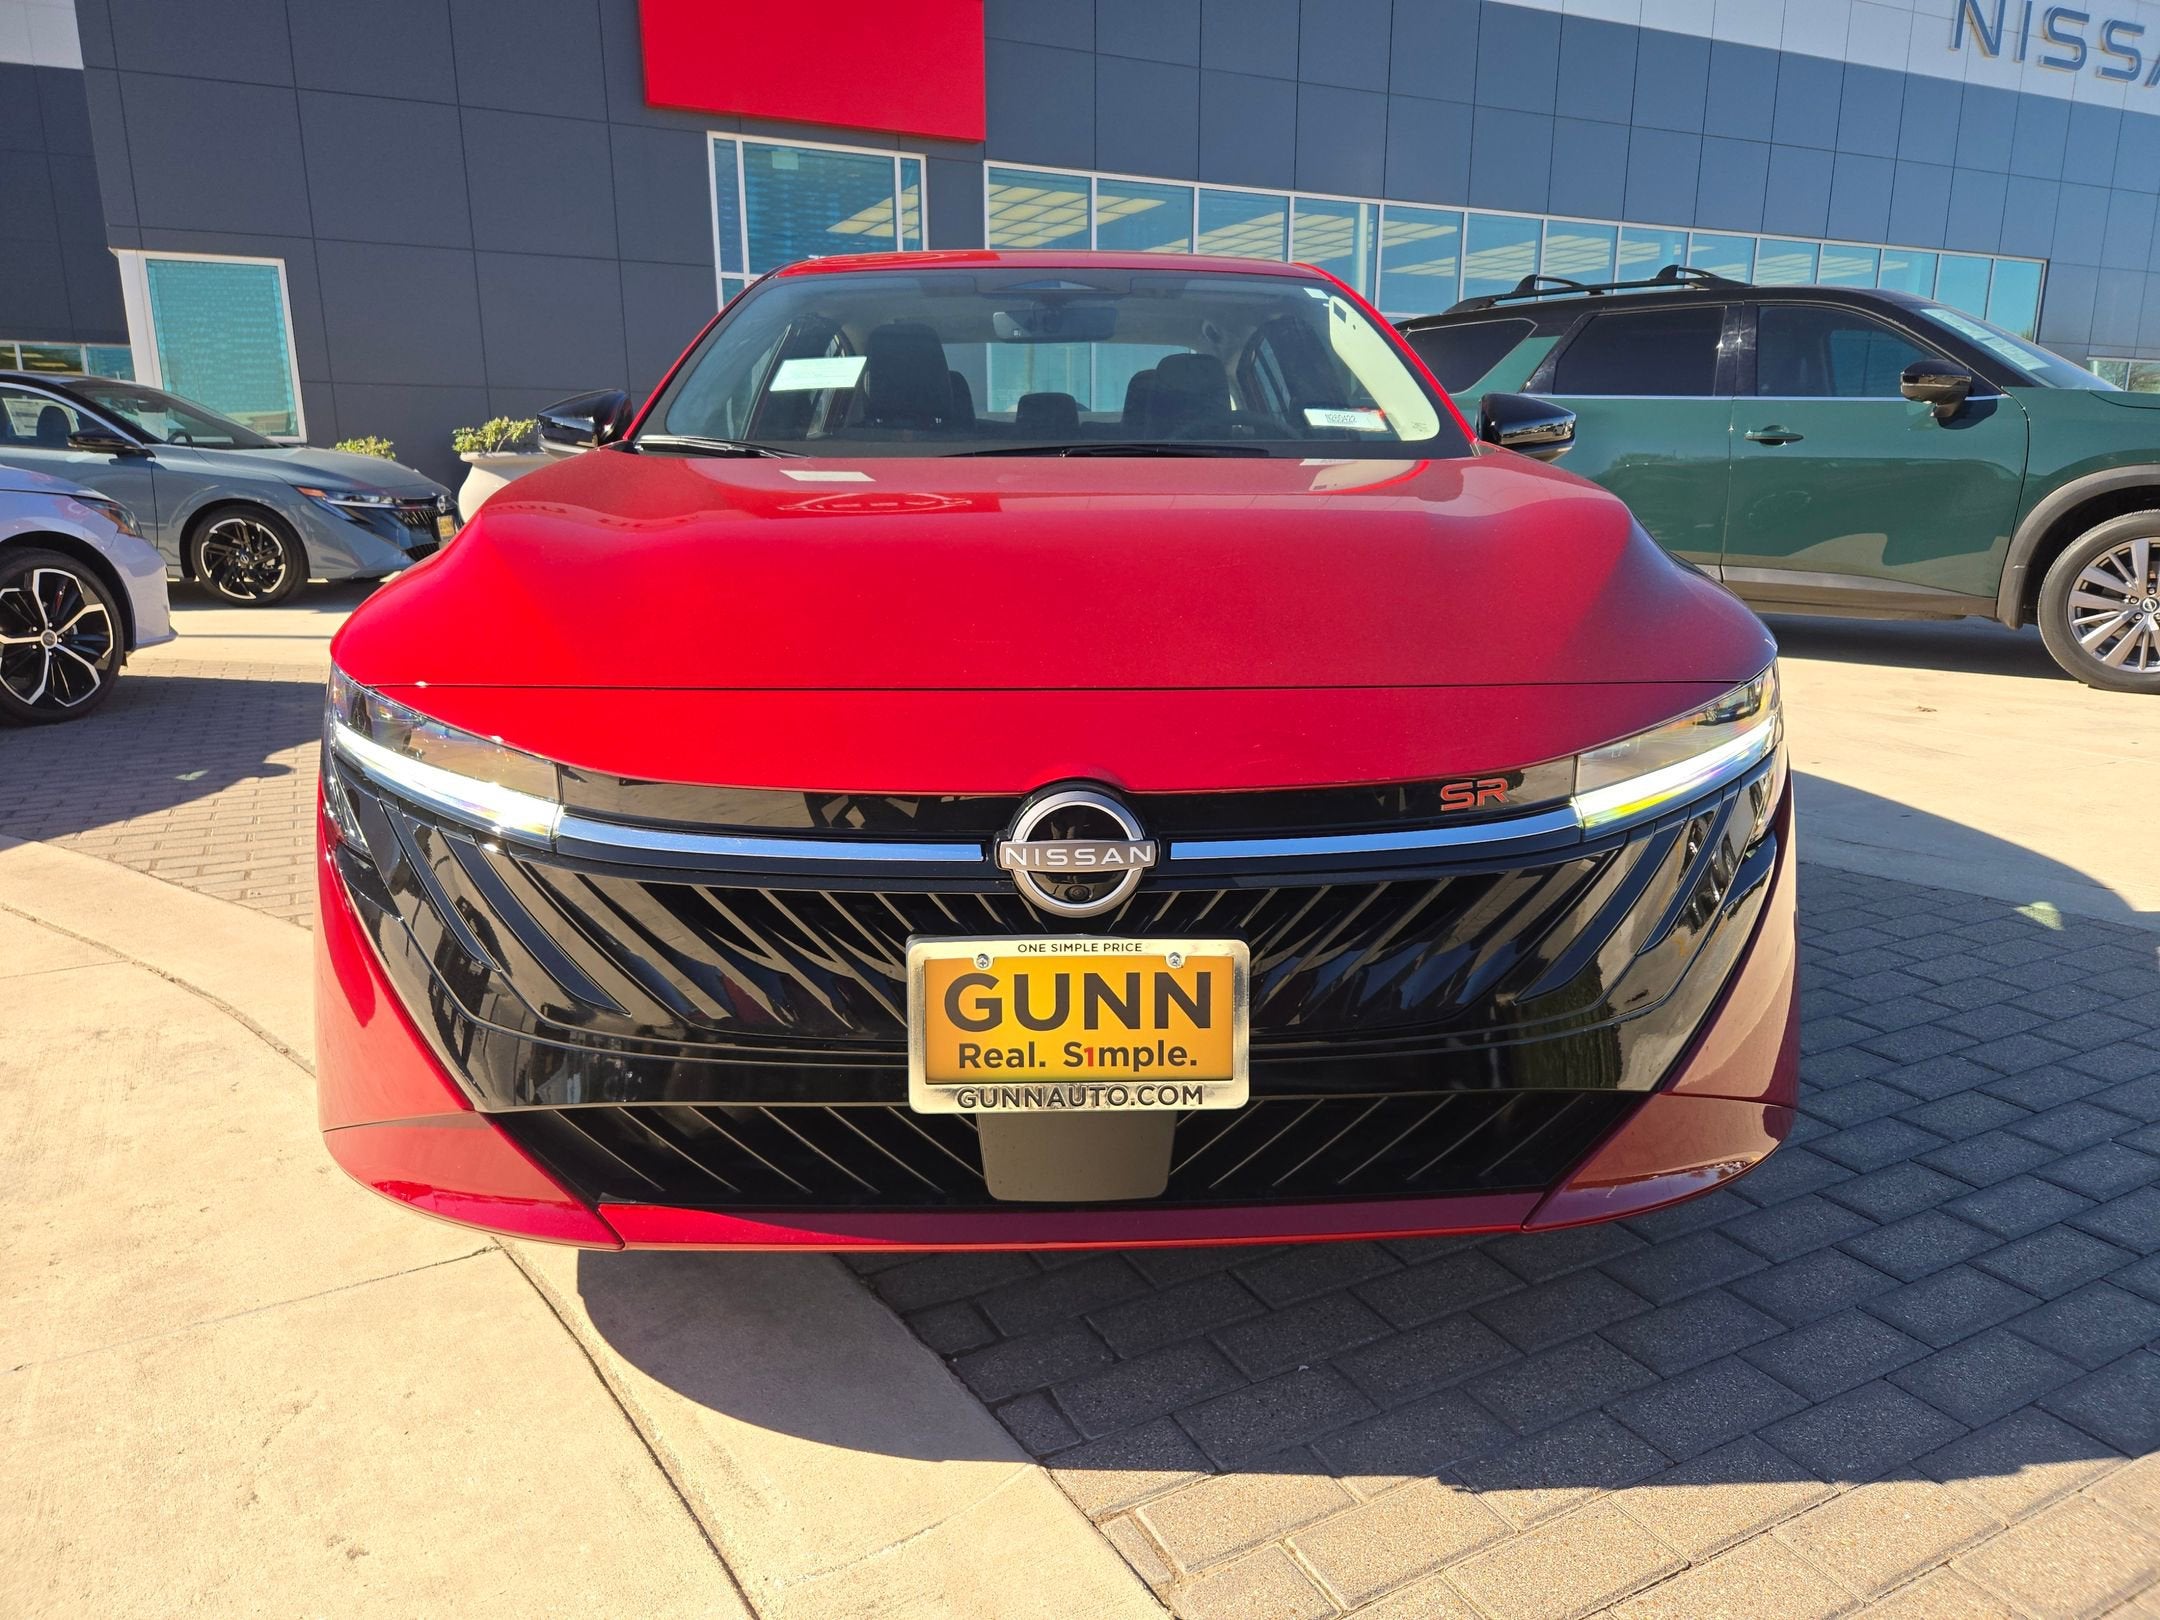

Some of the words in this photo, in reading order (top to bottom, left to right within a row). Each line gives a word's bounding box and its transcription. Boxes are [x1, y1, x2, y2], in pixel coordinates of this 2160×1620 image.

[1950, 0, 2160, 87] NISS
[1440, 777, 1509, 811] SR
[1005, 845, 1151, 866] NISSAN
[1017, 943, 1046, 953] ONE
[1050, 943, 1099, 953] SIMPLE
[1103, 942, 1143, 952] PRICE
[944, 971, 1212, 1032] GUNN
[958, 1041, 1046, 1068] Real.
[1063, 1040, 1198, 1072] S1mple.
[956, 1085, 1204, 1109] GUNNAUTO.COM
